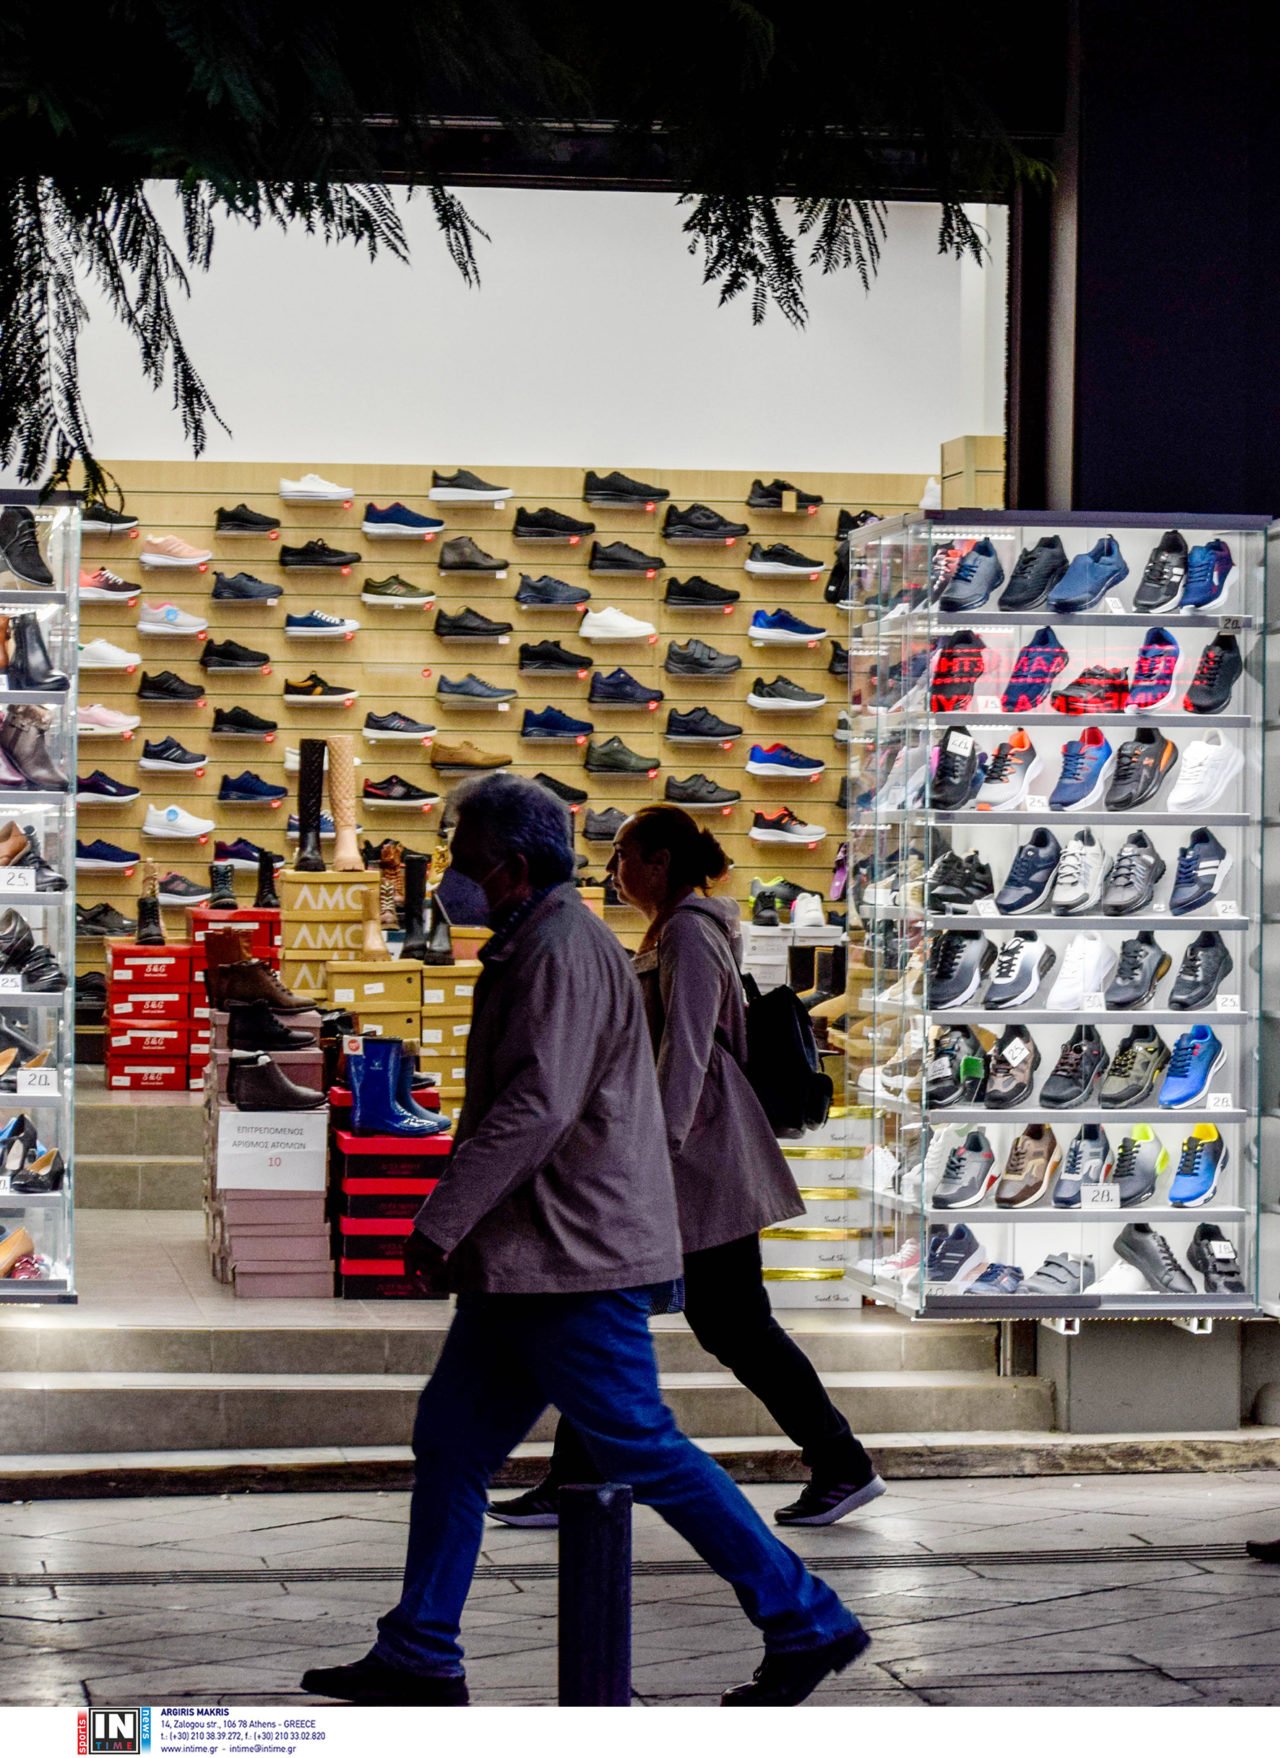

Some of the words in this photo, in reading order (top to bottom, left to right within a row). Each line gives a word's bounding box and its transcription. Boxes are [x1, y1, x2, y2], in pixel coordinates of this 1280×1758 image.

[237, 1126, 304, 1136] ΕΠΙΤΡΕΠΟΜΕΝΟΣ
[232, 1140, 269, 1149] ΑΡΙΘΜΟΣ
[270, 1141, 306, 1150] ΑΤΟΜΩΝ
[267, 1157, 282, 1167] 10
